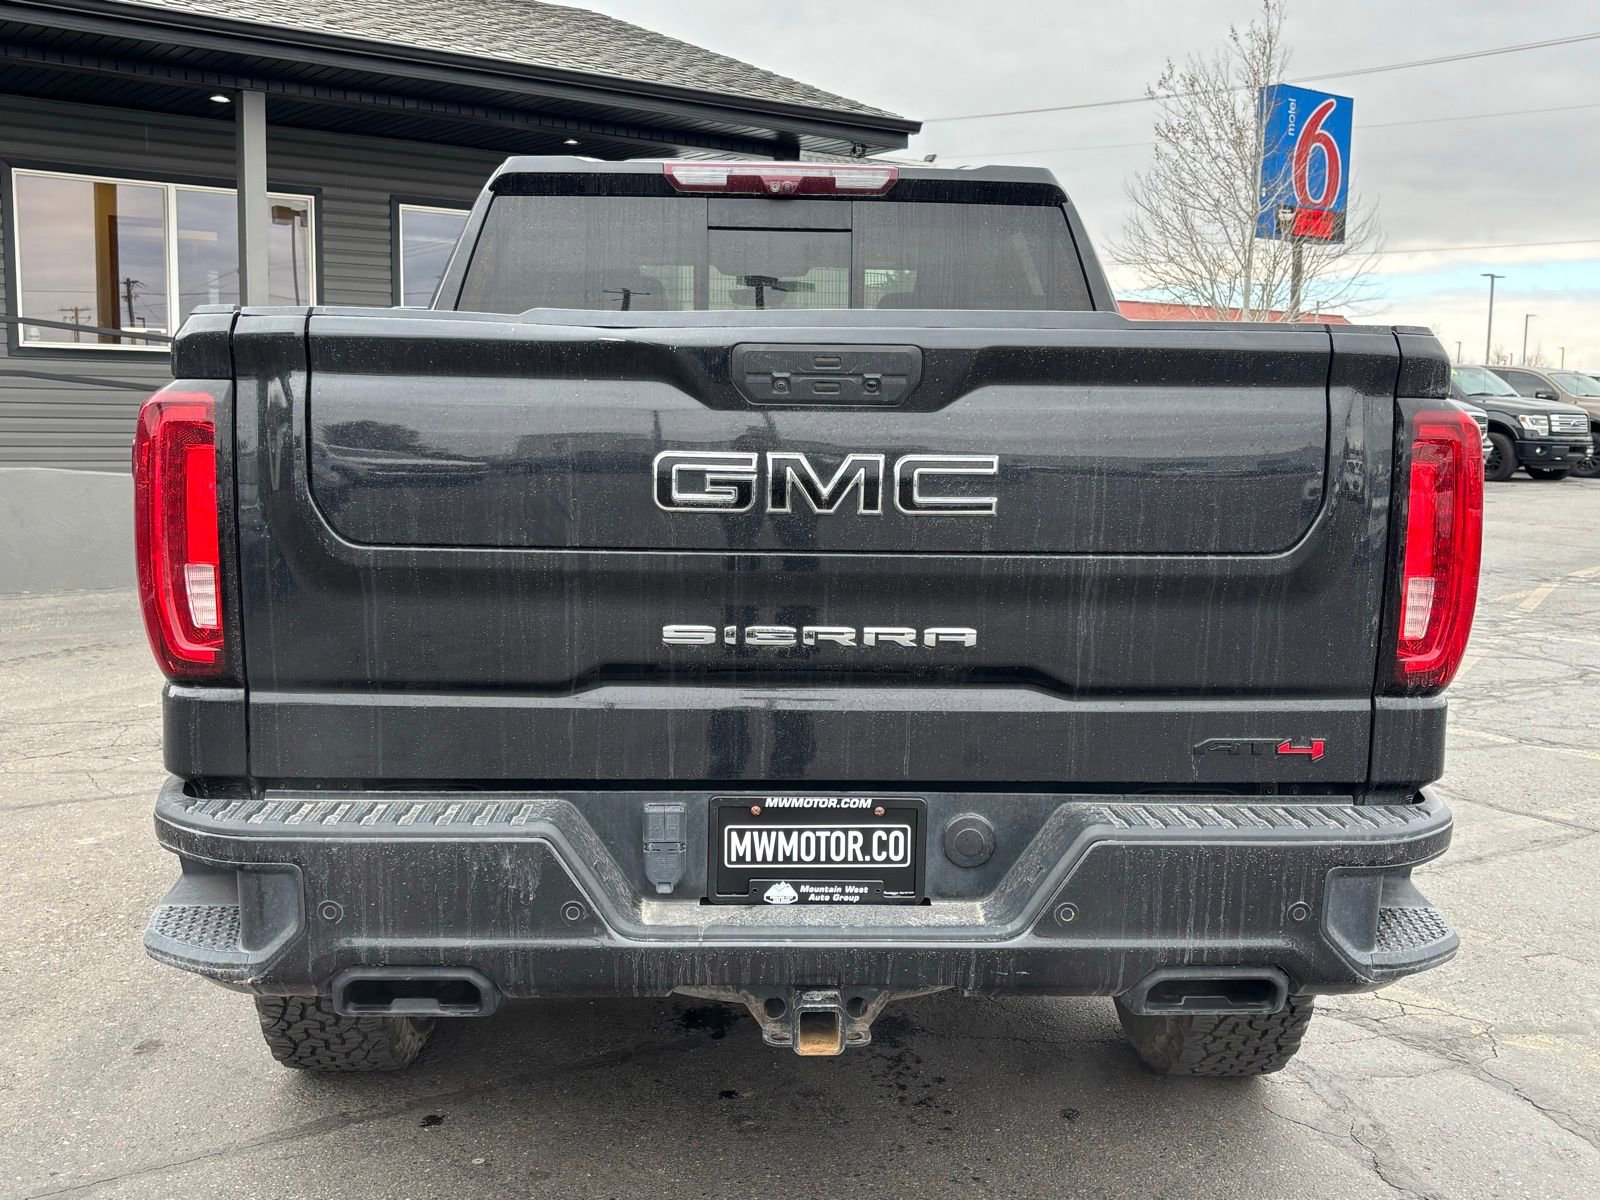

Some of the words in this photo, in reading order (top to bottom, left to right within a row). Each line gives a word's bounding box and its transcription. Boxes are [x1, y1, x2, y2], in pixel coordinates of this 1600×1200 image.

[1288, 98, 1296, 136] motel
[1293, 99, 1341, 208] 6
[653, 451, 999, 516] GMC
[662, 625, 977, 647] SIERRA
[1194, 738, 1326, 762] AT4
[764, 798, 872, 809] MWMOTOR.COM
[730, 831, 905, 862] MWMOTOR.CO
[800, 885, 842, 894] Mountain
[845, 885, 869, 894] West
[809, 893, 832, 901] Auto
[833, 893, 860, 903] Group
